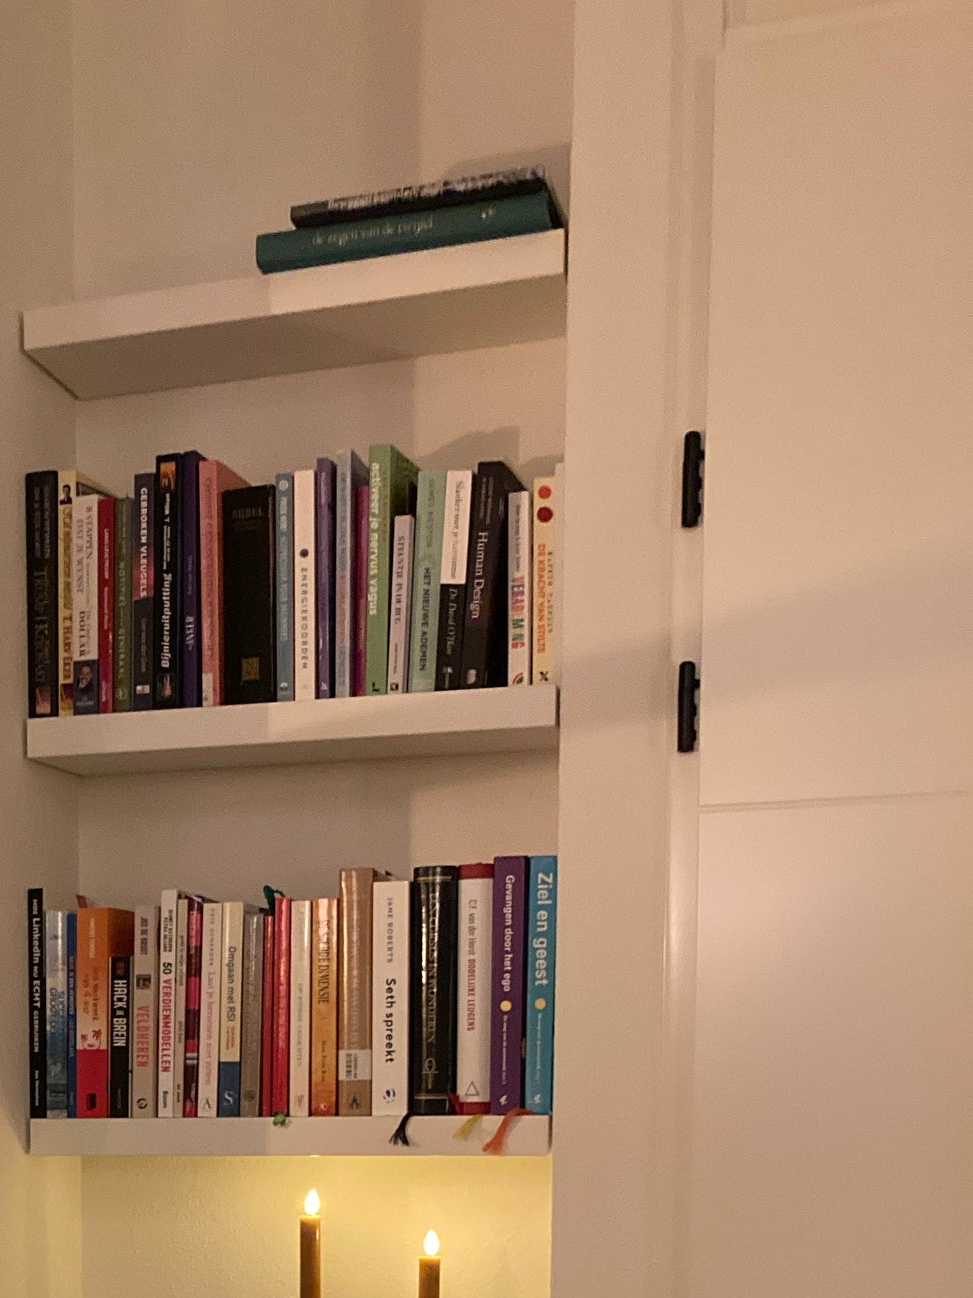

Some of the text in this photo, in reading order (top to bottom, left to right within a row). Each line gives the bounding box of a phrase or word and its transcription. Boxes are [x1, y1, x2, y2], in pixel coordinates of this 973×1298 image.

[139, 487, 149, 599] GEBROKEN VLEUGELS
[367, 462, 382, 616] activeer je nervus vagus
[475, 531, 489, 576] Human
[161, 572, 173, 669] Bijnieruitputting
[300, 567, 309, 669] ENERGIEKOORDEN
[418, 567, 432, 672] HET NIEUWE ADEMEN
[470, 578, 486, 619] Design
[537, 543, 546, 654] DE KRACHT VAN STILTE
[79, 610, 87, 657] DOLLAR
[32, 917, 41, 964] LinkedIn
[386, 897, 394, 964] JANE ROBERTS
[427, 915, 438, 963] CURSUS
[467, 912, 476, 925] van
[501, 874, 516, 992] Gevangen door het ego
[532, 871, 554, 987] Ziel en geest
[33, 979, 41, 1009] ECHT
[113, 979, 128, 1009] HACK
[162, 961, 173, 975] 50
[225, 945, 237, 1022] Omgaan met RSI
[317, 964, 331, 1005] DIMENSIE
[427, 963, 437, 976] IN
[466, 957, 476, 997] DODELIJKE
[112, 1017, 127, 1047] BREIN
[136, 1005, 150, 1068] VELDHEREN
[160, 977, 173, 1073] VERDIENMODELLEN
[382, 977, 397, 1064] Seth spreekt
[426, 978, 437, 1045] WONDEREN
[466, 998, 476, 1032] LEUGENS
